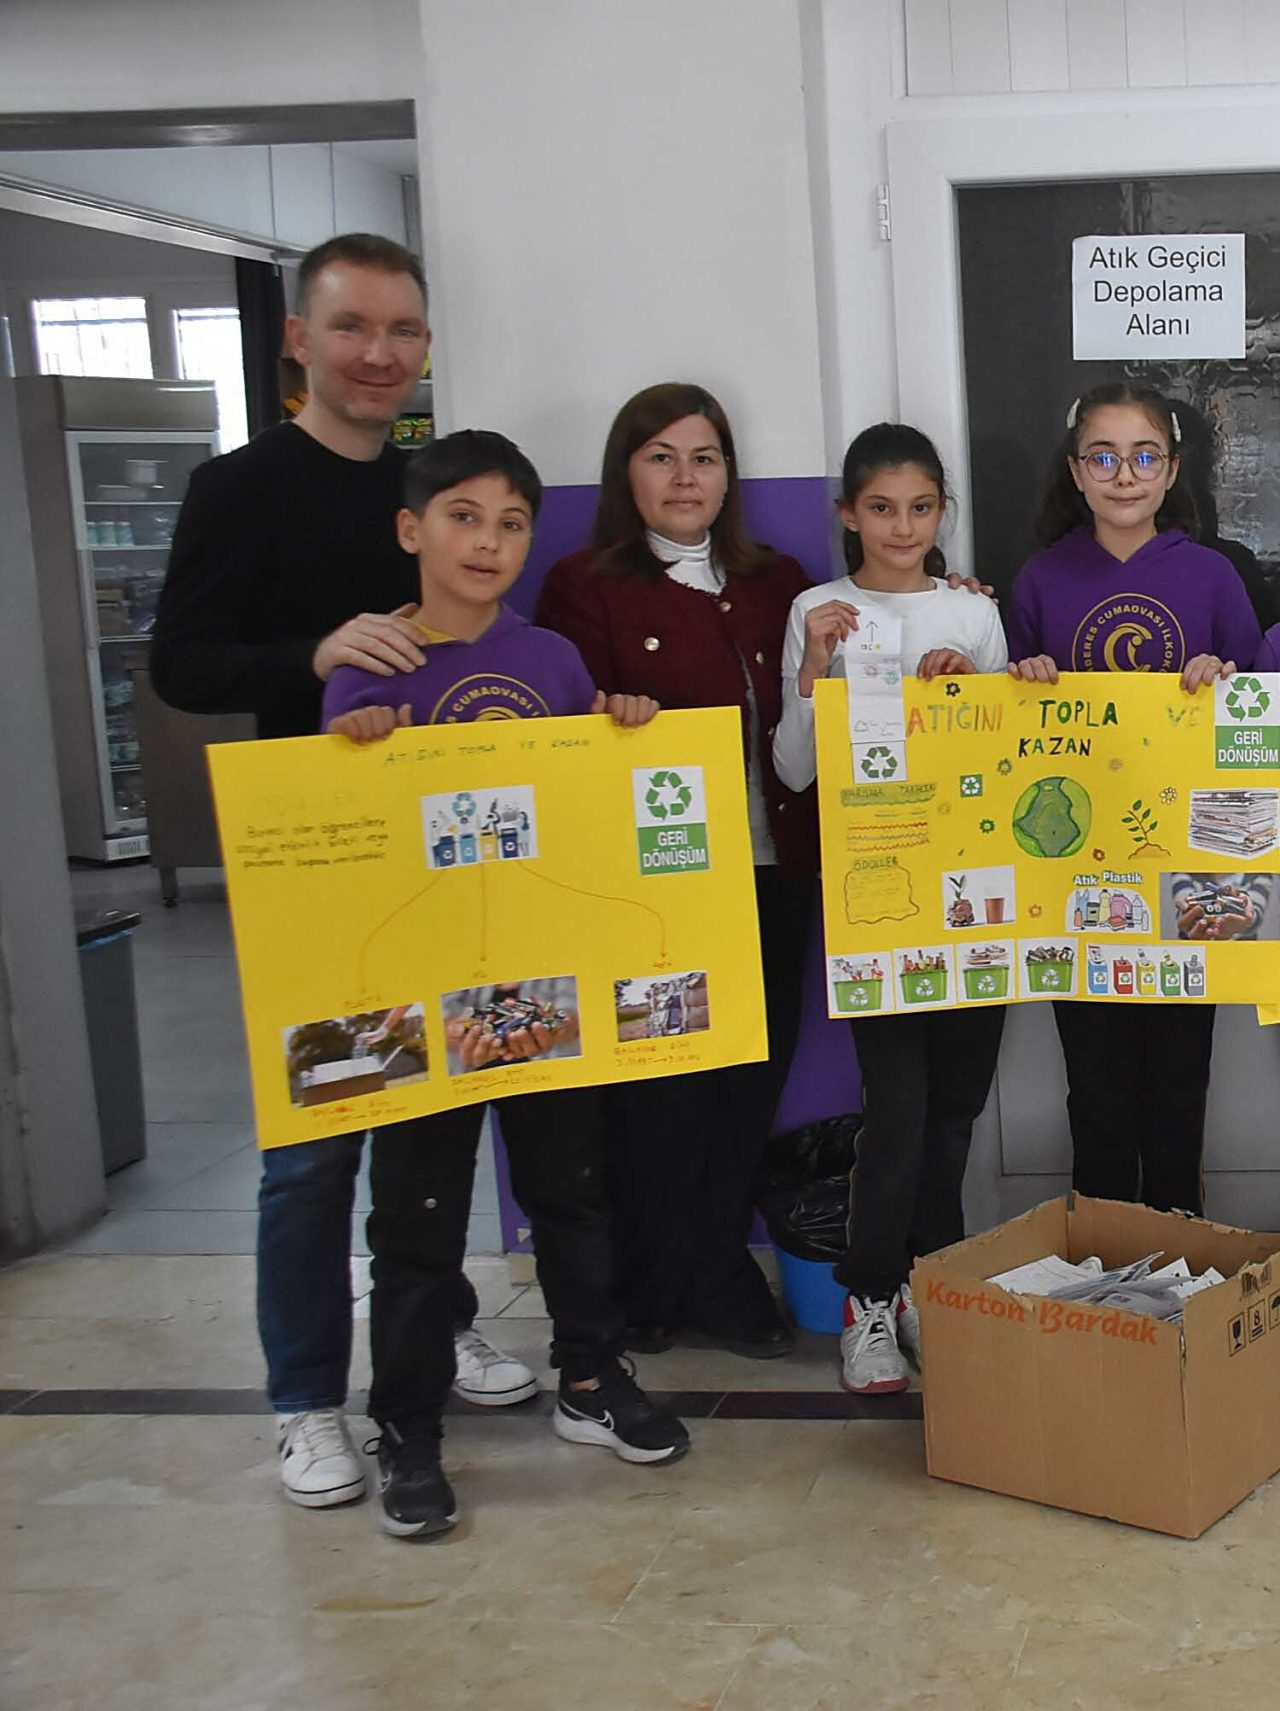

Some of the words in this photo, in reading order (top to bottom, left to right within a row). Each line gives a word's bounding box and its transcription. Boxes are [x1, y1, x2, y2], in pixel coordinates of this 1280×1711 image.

[1089, 246, 1139, 269] Atık
[1148, 245, 1226, 274] Geçici
[1094, 279, 1223, 308] Depolama
[1126, 313, 1190, 336] Alanı
[1096, 604, 1165, 628] CUMAOVASI
[1038, 698, 1119, 729] TOPLA
[1018, 736, 1092, 758] KAZAN
[1234, 728, 1264, 746] GERİ
[1218, 746, 1279, 767] DÖNÜŞÜM
[657, 826, 688, 847] GERİ
[642, 846, 706, 869] DÖNÜŞÜM
[1074, 874, 1098, 886] Atık
[1102, 870, 1144, 884] Plastik
[926, 1278, 1026, 1324] Karton
[1038, 1300, 1159, 1345] Bardak
